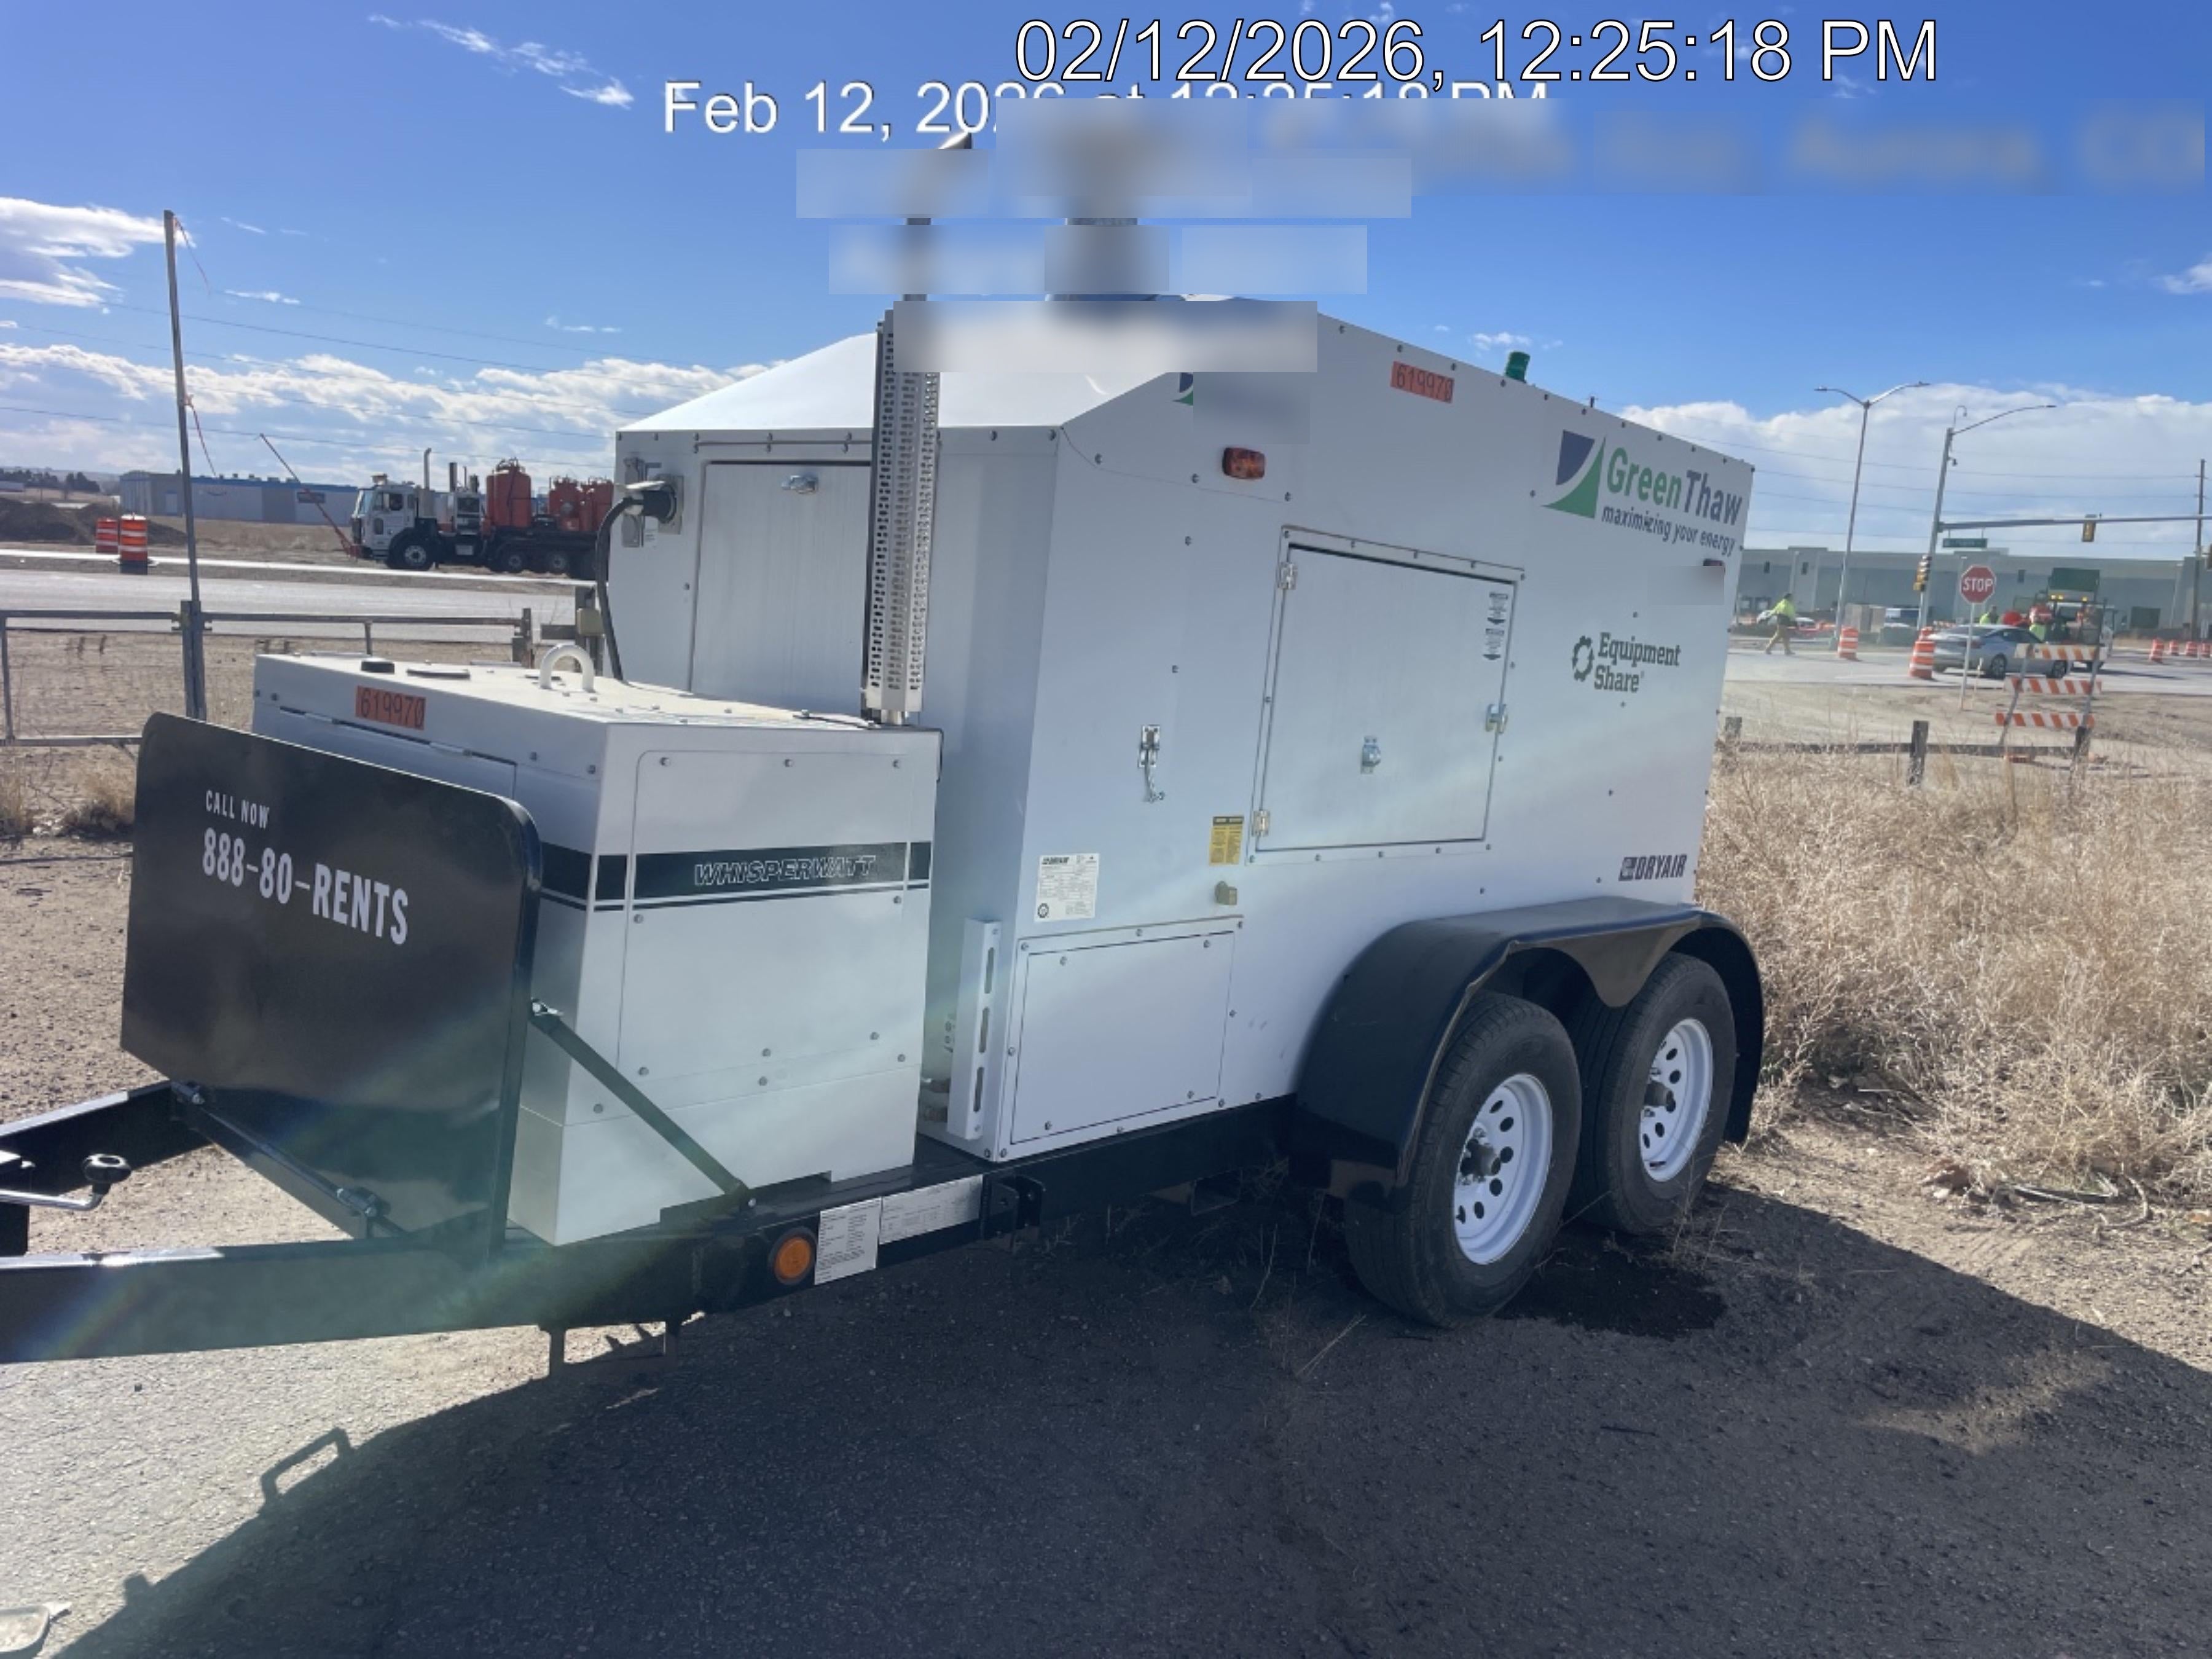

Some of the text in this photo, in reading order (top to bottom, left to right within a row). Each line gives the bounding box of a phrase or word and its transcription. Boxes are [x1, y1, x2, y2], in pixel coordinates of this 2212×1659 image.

[1397, 363, 1454, 403] 619970
[1607, 447, 1743, 525] GreenThaw
[1672, 523, 1698, 544] your
[1700, 530, 1736, 557] energy
[1963, 578, 1993, 592] STOP
[1598, 632, 1681, 667] Equipment
[361, 686, 426, 730] 619970
[206, 790, 270, 829] CALL NOW
[203, 827, 409, 945] 888-80-RENTS
[694, 855, 876, 886] WHISPERWATT
